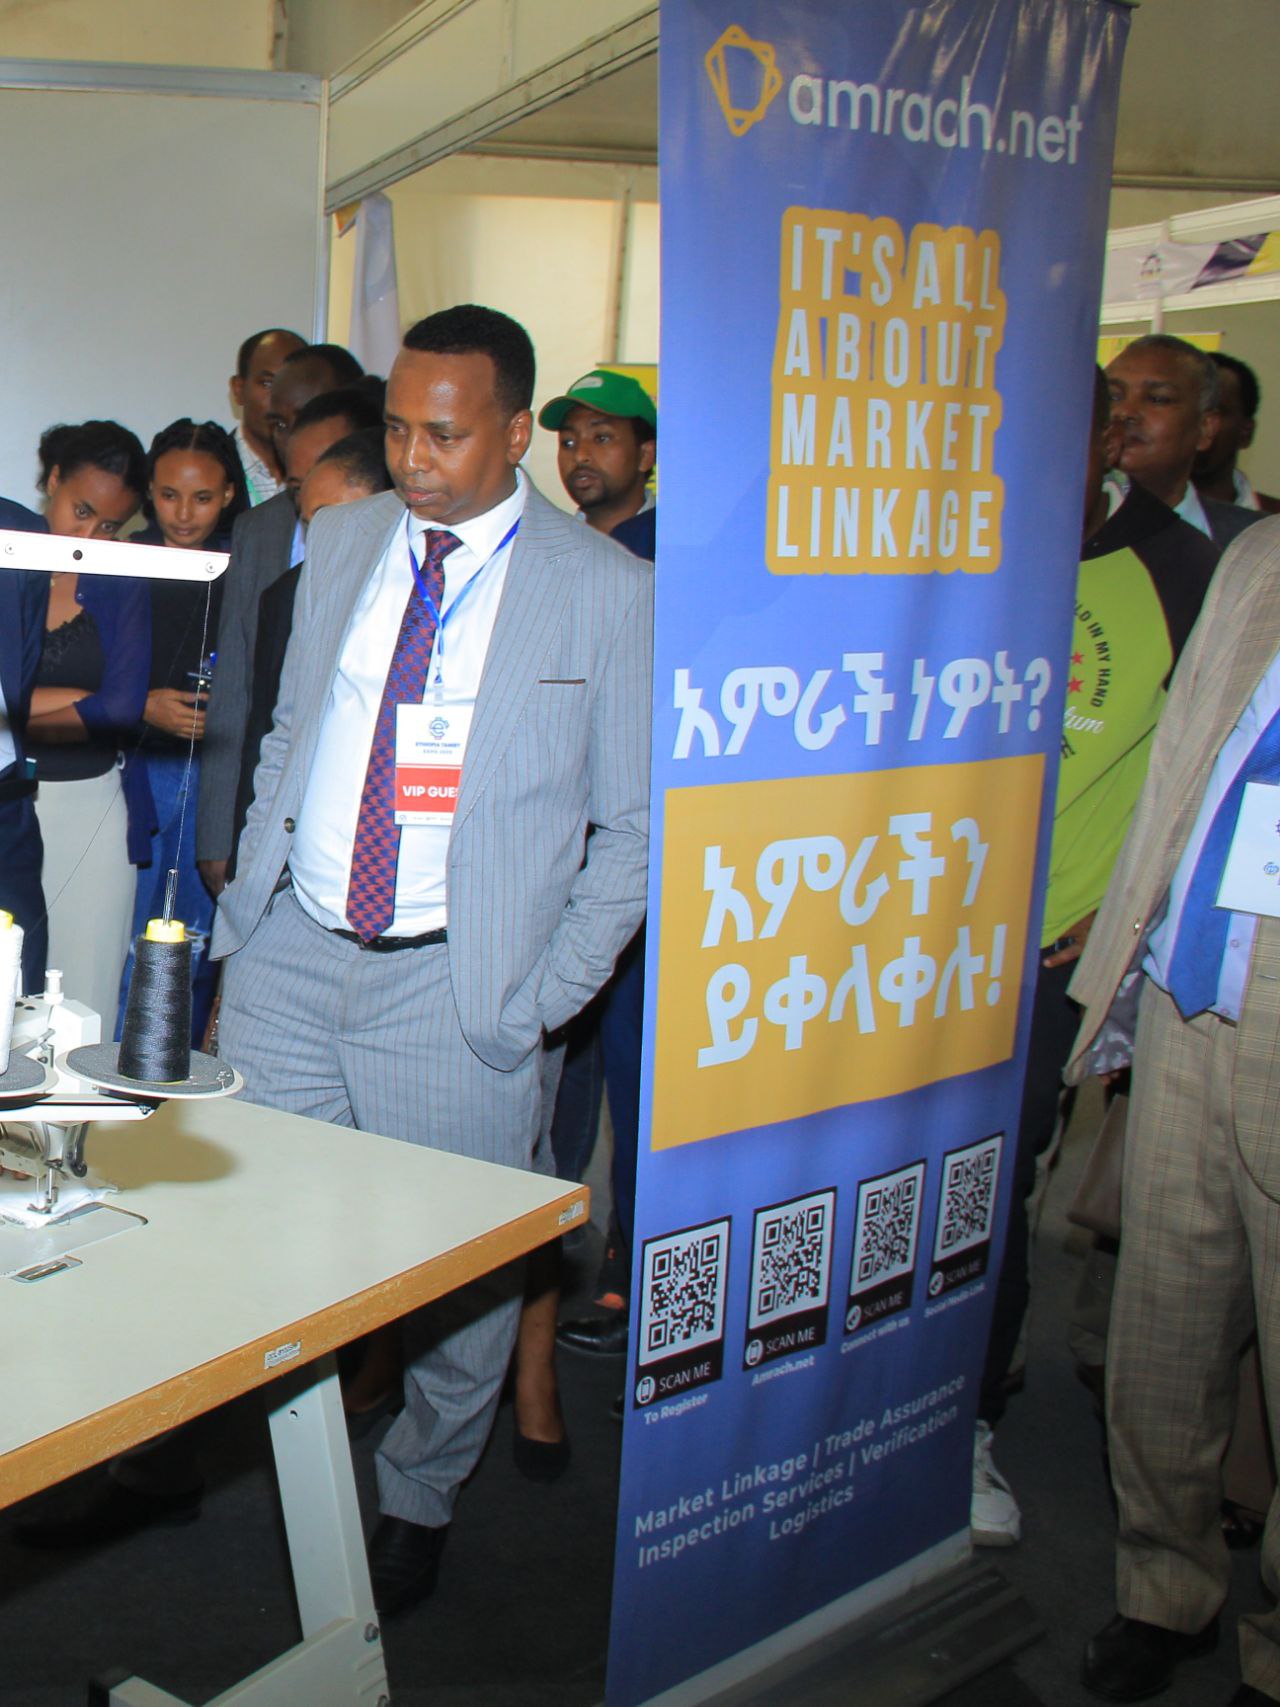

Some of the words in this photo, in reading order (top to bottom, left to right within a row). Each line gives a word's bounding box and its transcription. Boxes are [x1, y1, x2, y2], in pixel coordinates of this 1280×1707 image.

[788, 73, 1084, 164] amrach.net
[791, 224, 895, 306] IT'S
[912, 240, 999, 311] ALL
[782, 307, 994, 389] ABOUT
[780, 392, 992, 473] MARKET
[776, 484, 995, 559] LINKAGE
[1086, 621, 1104, 639] IN
[1095, 641, 1111, 662] MY
[672, 651, 895, 760] አምራች
[907, 650, 1052, 741] ነዎት?
[1089, 667, 1112, 708] HAND
[402, 785, 426, 797] VIP
[700, 812, 989, 949] አምራችን
[696, 924, 1008, 1069] ይቀላቀሉ!
[863, 1297, 888, 1318] SCAN
[888, 1290, 905, 1308] ME
[765, 1333, 796, 1354] SCAN
[797, 1327, 816, 1344] ME
[840, 1329, 877, 1354] Connect
[643, 1411, 658, 1425] To
[660, 1393, 709, 1418] Register
[659, 1370, 691, 1392] SCAN
[693, 1361, 711, 1379] ME
[634, 1486, 714, 1538] Market
[721, 1452, 807, 1502] Linkage
[825, 1417, 875, 1456] Trade
[880, 1373, 966, 1430] Assurance
[638, 1503, 754, 1569] Inspection
[762, 1460, 844, 1514] Services
[860, 1404, 958, 1466] Verification
[768, 1484, 855, 1541] Logistics
